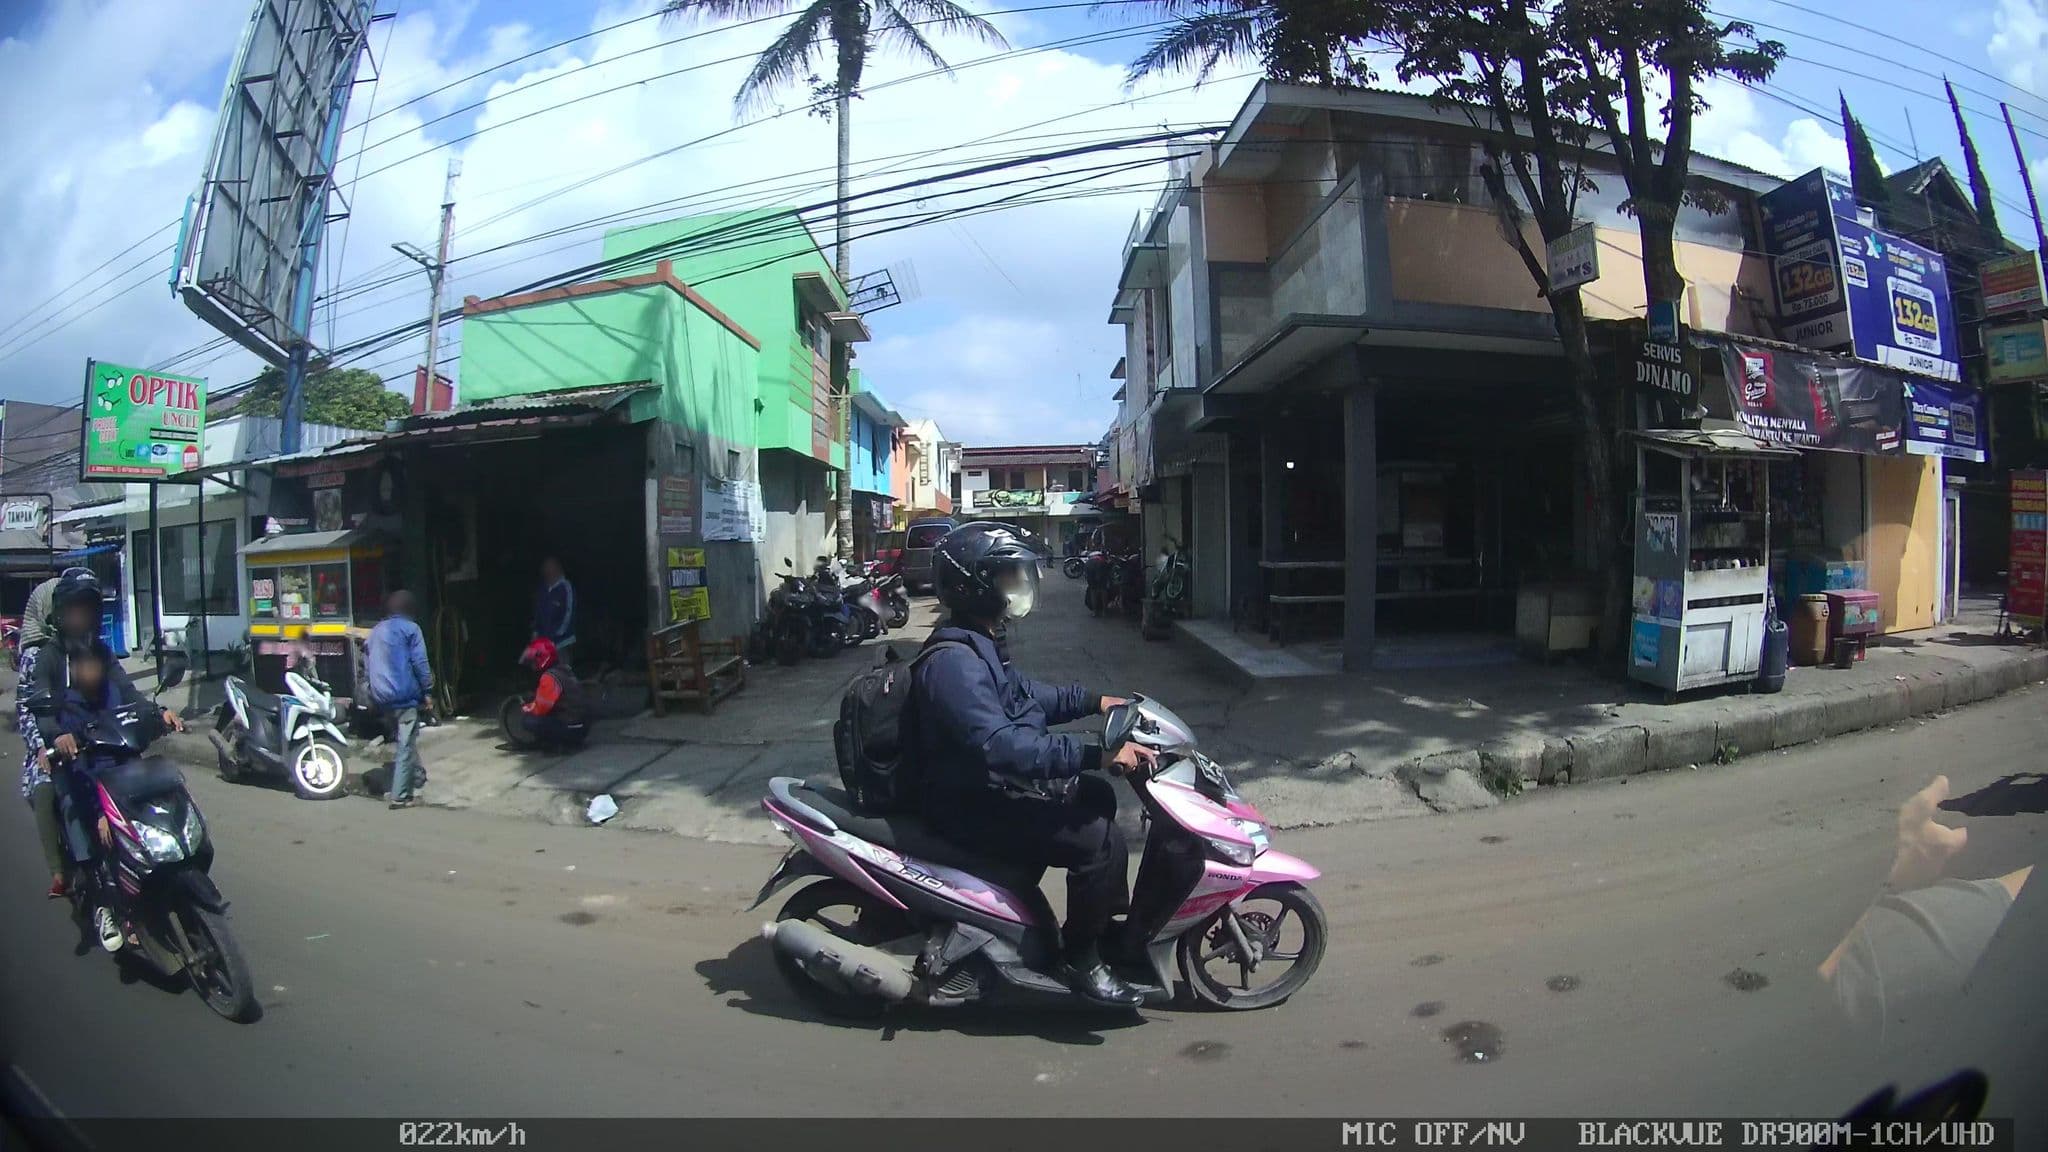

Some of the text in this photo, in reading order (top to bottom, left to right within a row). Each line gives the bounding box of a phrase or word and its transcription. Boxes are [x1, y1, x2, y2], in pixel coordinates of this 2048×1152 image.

[1796, 320, 1834, 341] JUNIOR
[1643, 342, 1682, 363] SERVIS
[1908, 355, 1934, 371] JUNIOR
[1636, 361, 1692, 395] DINAMO
[128, 373, 200, 412] OPTIK
[162, 411, 200, 428] UNCLE
[1770, 416, 1807, 432] MENYALA
[1782, 432, 1792, 442] KE
[1208, 872, 1243, 881] HONDA
